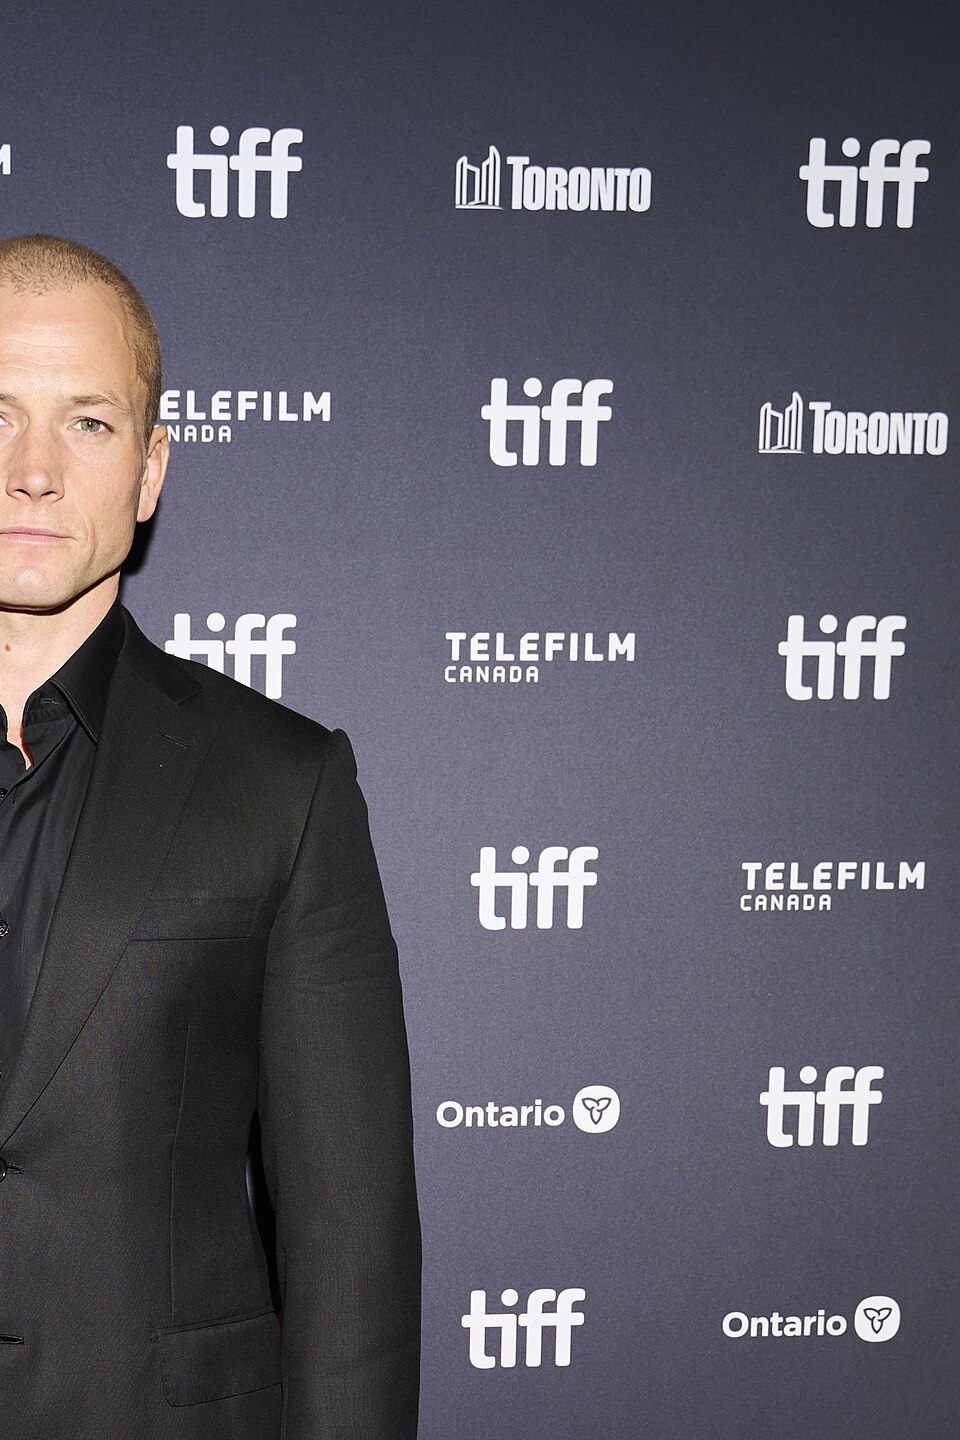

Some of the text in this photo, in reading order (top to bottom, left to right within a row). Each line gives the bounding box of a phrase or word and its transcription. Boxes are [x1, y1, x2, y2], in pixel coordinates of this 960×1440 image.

[167, 126, 303, 218] tiff
[507, 156, 651, 212] TORONTO
[799, 138, 930, 228] tiff
[160, 390, 331, 422] ELEFILM
[481, 378, 613, 466] tiff
[809, 402, 948, 455] TORONTO
[166, 424, 232, 443] NADA
[446, 632, 635, 661] TELEFILM
[778, 615, 906, 700] tiff
[445, 666, 538, 682] CANADA
[471, 846, 598, 930] tiff
[740, 894, 831, 911] CANADA
[742, 862, 925, 890] TELEFILM
[436, 1099, 565, 1127] Ontario
[760, 1066, 884, 1147] tiff
[461, 1288, 585, 1369] tiff
[723, 1310, 847, 1337] Ontario
